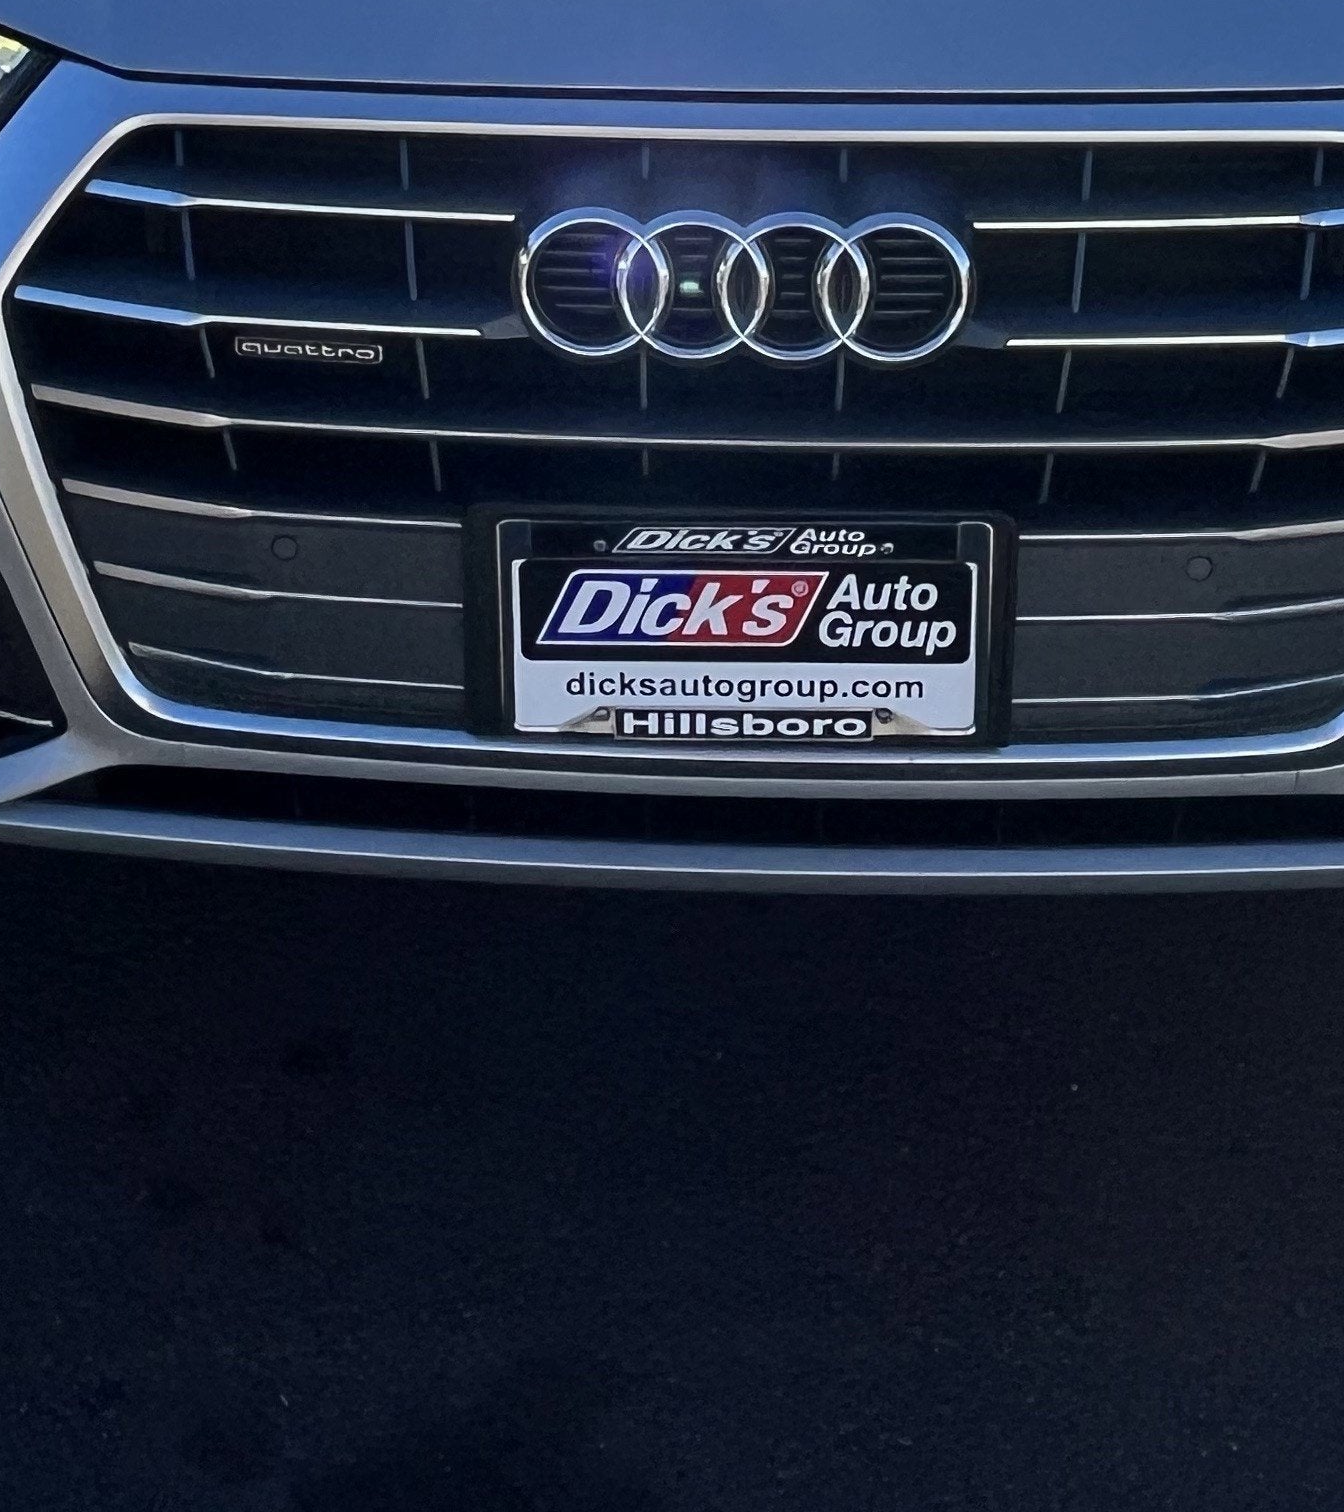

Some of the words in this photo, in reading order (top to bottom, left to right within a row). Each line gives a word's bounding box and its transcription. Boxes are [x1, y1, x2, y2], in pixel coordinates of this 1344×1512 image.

[242, 342, 375, 359] quattro
[627, 530, 776, 550] Dick's
[798, 528, 865, 542] Auto
[790, 541, 876, 557] Group
[826, 574, 938, 611] Auto
[557, 578, 794, 636] Dick's
[818, 611, 956, 655] Group
[566, 671, 924, 702] dicksautogroup.com
[622, 711, 867, 737] Hillsboro
